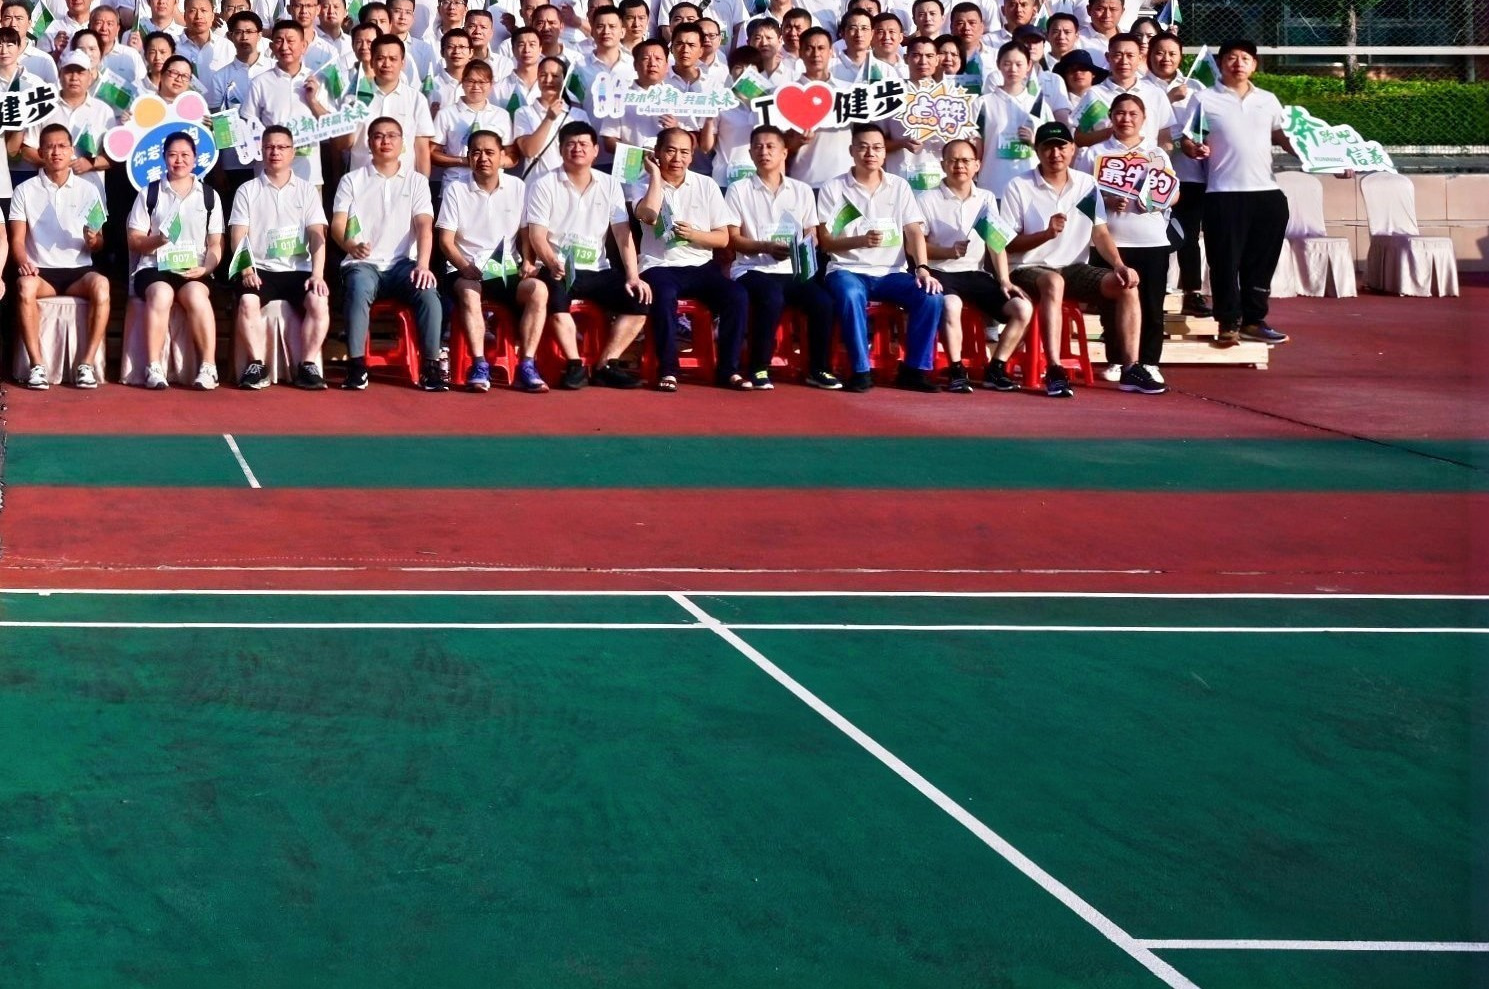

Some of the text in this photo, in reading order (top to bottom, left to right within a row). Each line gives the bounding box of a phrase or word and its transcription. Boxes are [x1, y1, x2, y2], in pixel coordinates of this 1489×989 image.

[832, 80, 904, 124] 健步
[908, 95, 966, 134] 点赞
[172, 253, 190, 263] 007
[575, 248, 593, 259] 139
